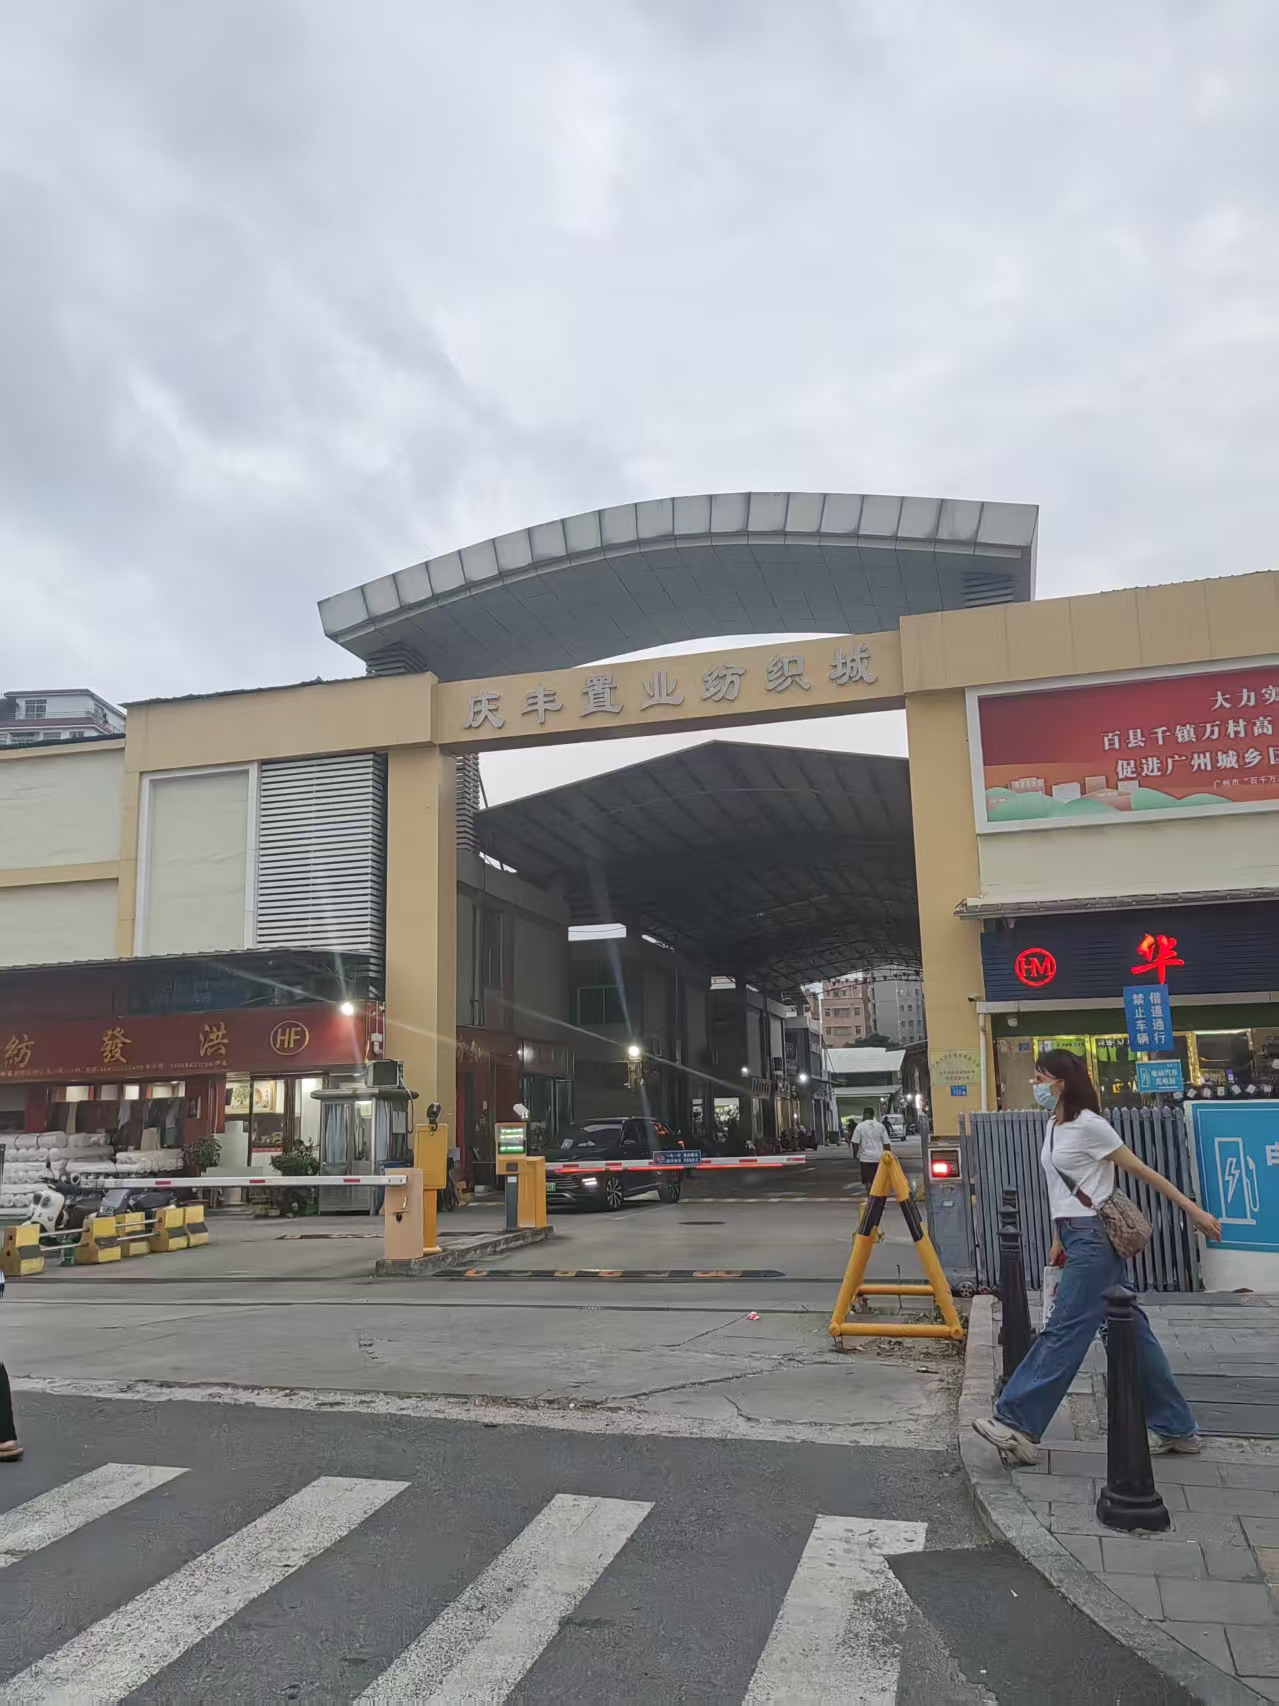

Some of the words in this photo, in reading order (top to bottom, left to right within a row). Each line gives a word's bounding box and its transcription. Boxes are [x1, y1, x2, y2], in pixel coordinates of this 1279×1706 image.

[464, 642, 878, 730] 庆丰置业纺织城
[1100, 716, 1273, 750] 百县千镇万村高
[1131, 933, 1185, 984] 华
[1131, 993, 1150, 1046] 禁止车辆
[1149, 992, 1166, 1045] 借道通行
